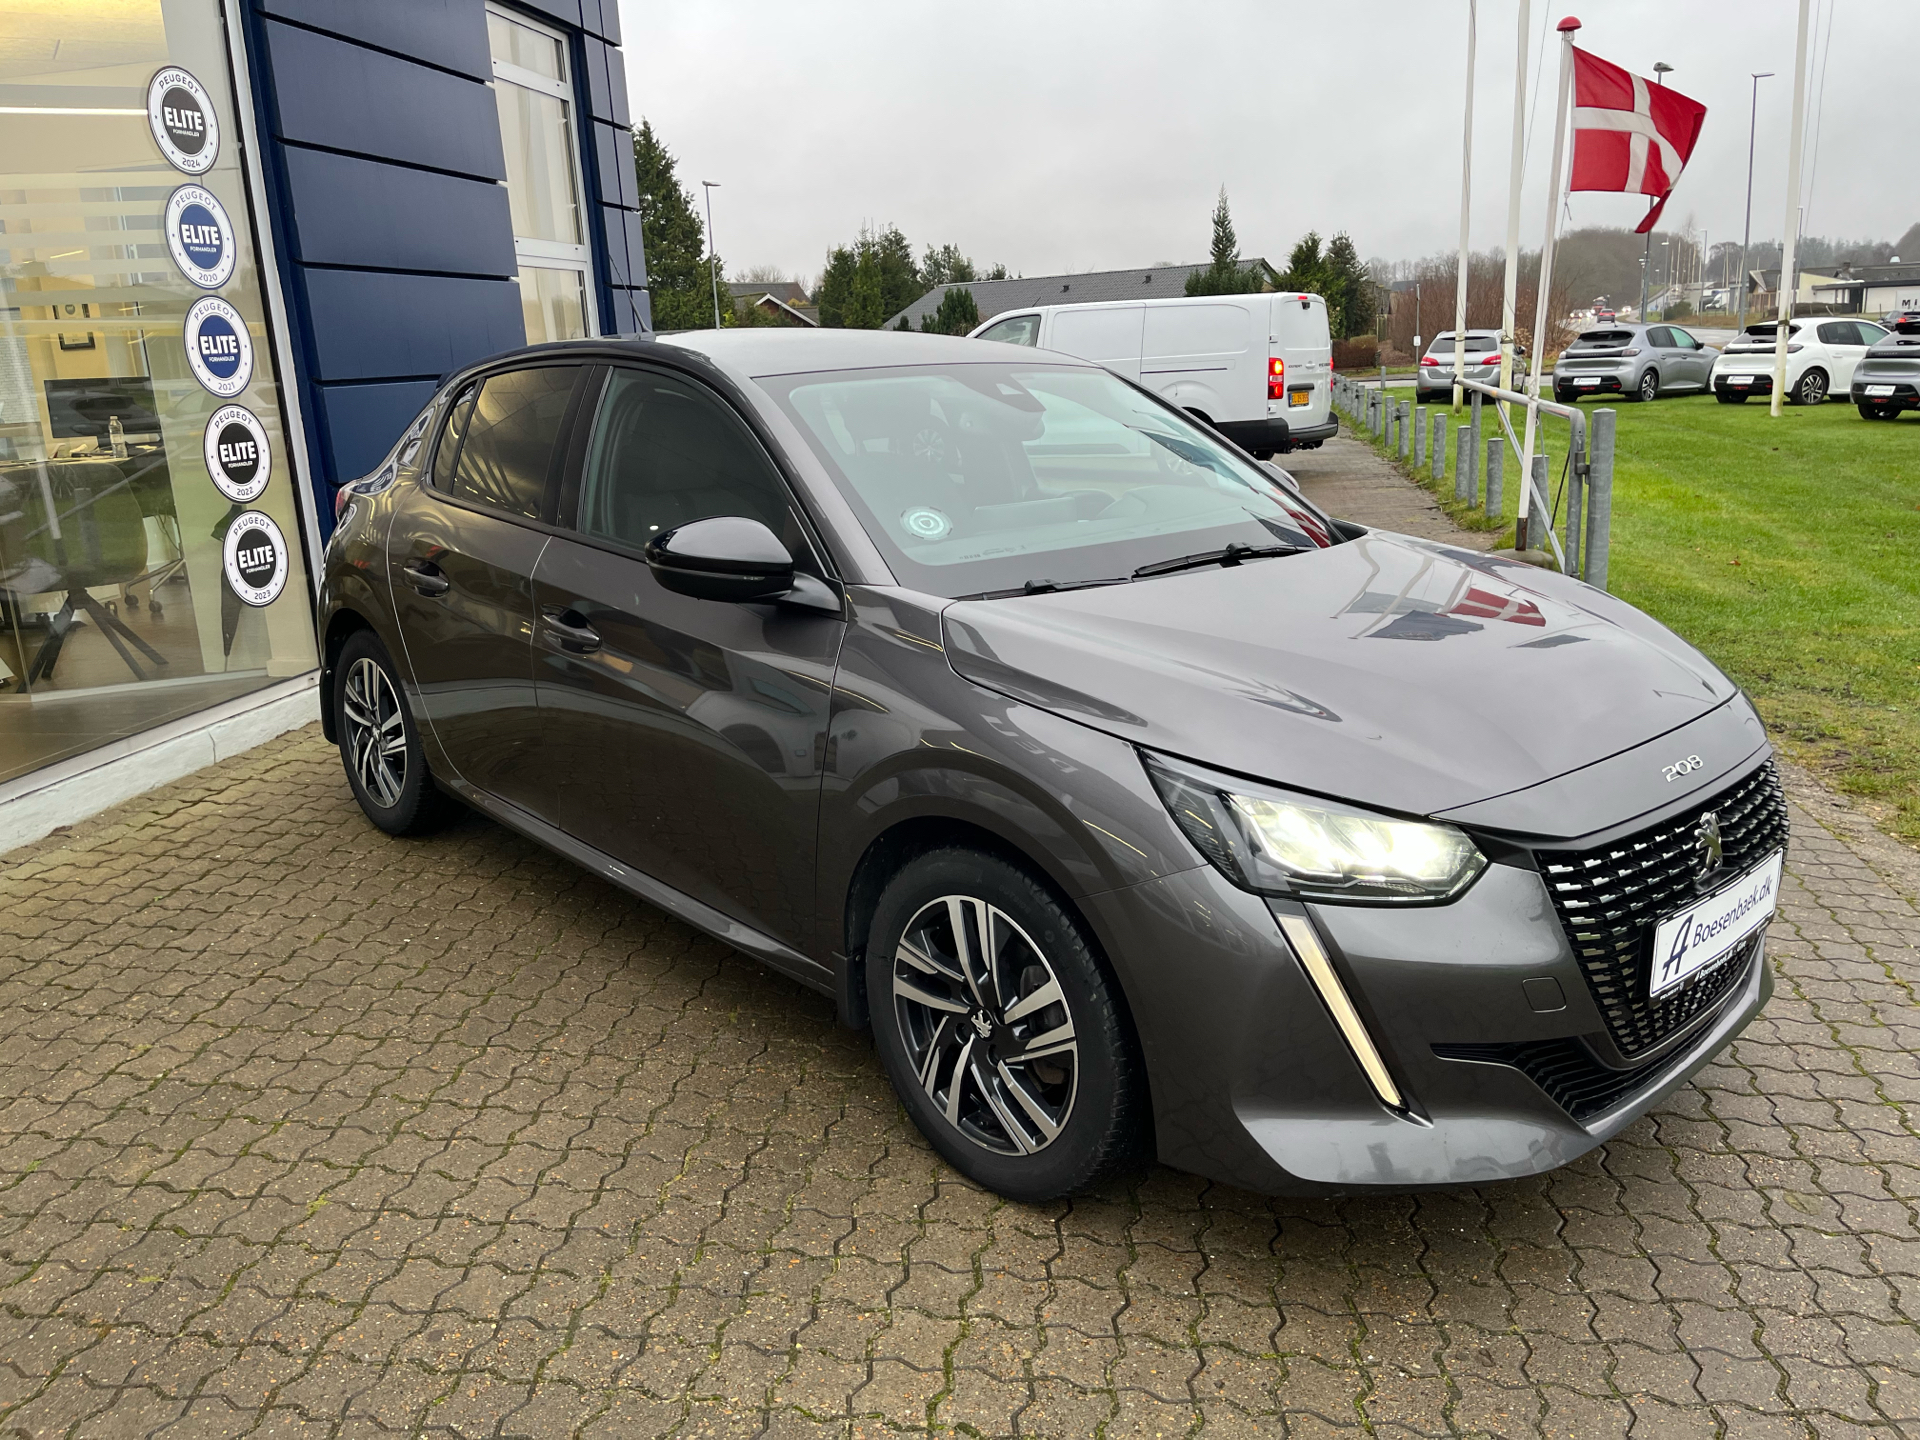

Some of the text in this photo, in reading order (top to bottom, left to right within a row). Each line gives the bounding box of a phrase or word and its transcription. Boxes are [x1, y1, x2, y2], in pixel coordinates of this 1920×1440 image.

[158, 73, 199, 94] PEUGEOT
[163, 107, 203, 131] ELITE
[182, 157, 201, 168] 2024
[175, 191, 216, 210] PEUGEOT
[180, 224, 220, 245] ELITE
[198, 272, 218, 283] 2020
[194, 303, 234, 320] PEUGEOT
[200, 335, 238, 355] ELITE
[208, 355, 236, 363] FORHANDLER
[217, 381, 237, 392] 2021
[214, 410, 252, 429] PEUGEOT
[219, 441, 257, 462] ELITE
[236, 486, 255, 497] 2022
[233, 517, 270, 536] PEUGEOT
[237, 545, 275, 570] ELITE
[254, 590, 272, 601] 2023
[1661, 754, 1704, 782] 208
[1692, 874, 1772, 948] Boesenbaek.dk
